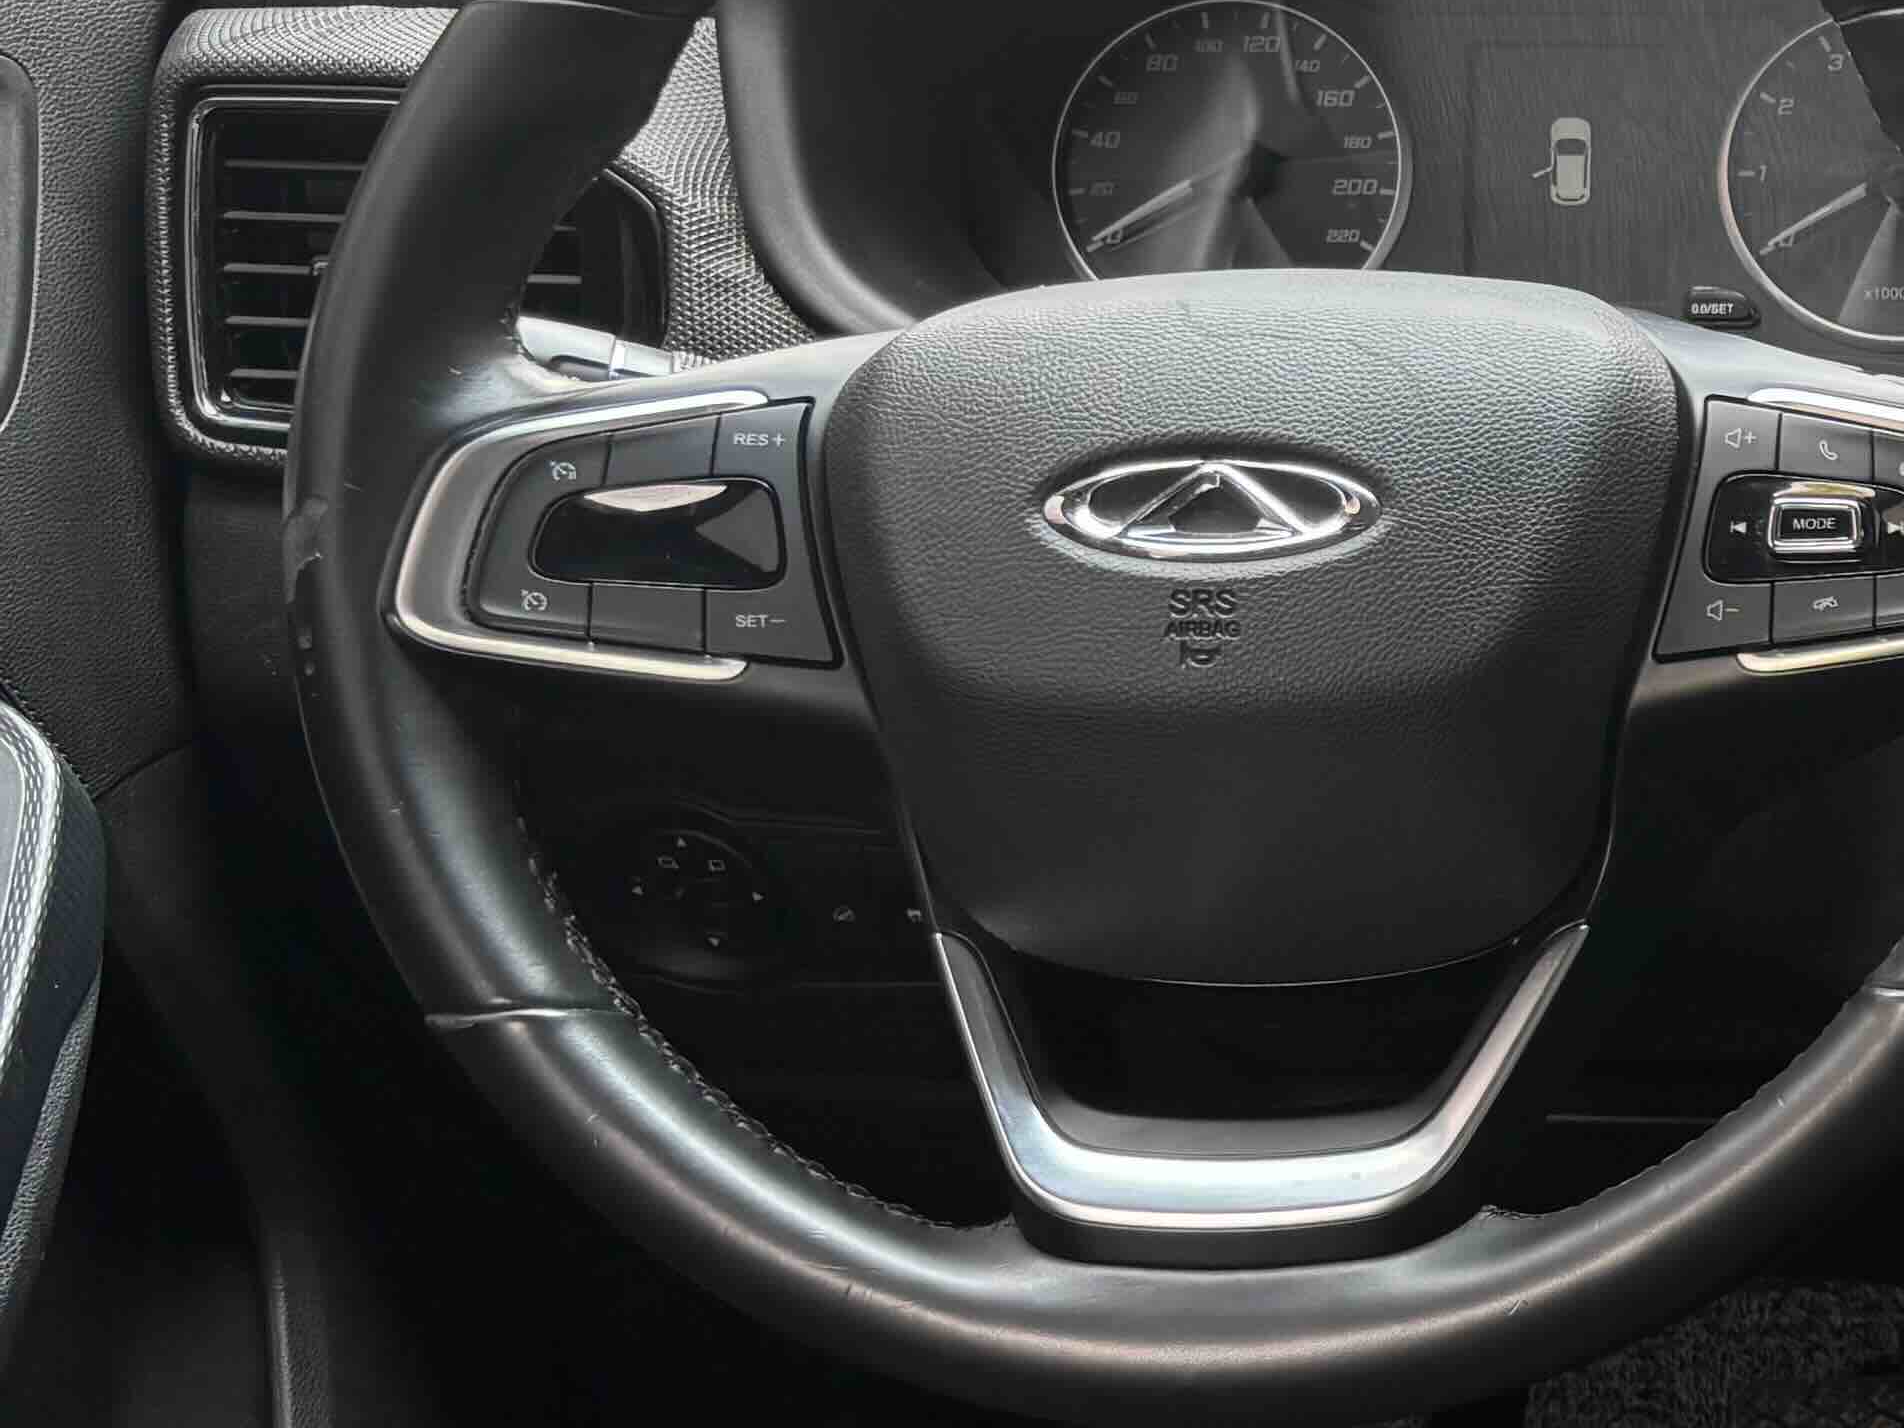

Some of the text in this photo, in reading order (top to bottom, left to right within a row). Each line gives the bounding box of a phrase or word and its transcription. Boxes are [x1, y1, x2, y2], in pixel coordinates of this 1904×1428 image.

[1195, 40, 1223, 52] 100
[1244, 35, 1280, 52] 120
[1146, 54, 1178, 72] 80
[1828, 54, 1844, 70] 3
[1316, 89, 1354, 107] 160
[1777, 99, 1794, 115] 2
[1090, 131, 1121, 149] 40
[1344, 136, 1372, 149] 180
[1760, 164, 1768, 181] 1
[1331, 179, 1378, 196] 200
[1326, 229, 1361, 243] 220
[1793, 517, 1837, 530] MODE
[1170, 589, 1239, 619] SRS
[1163, 621, 1242, 641] AIRBAG
